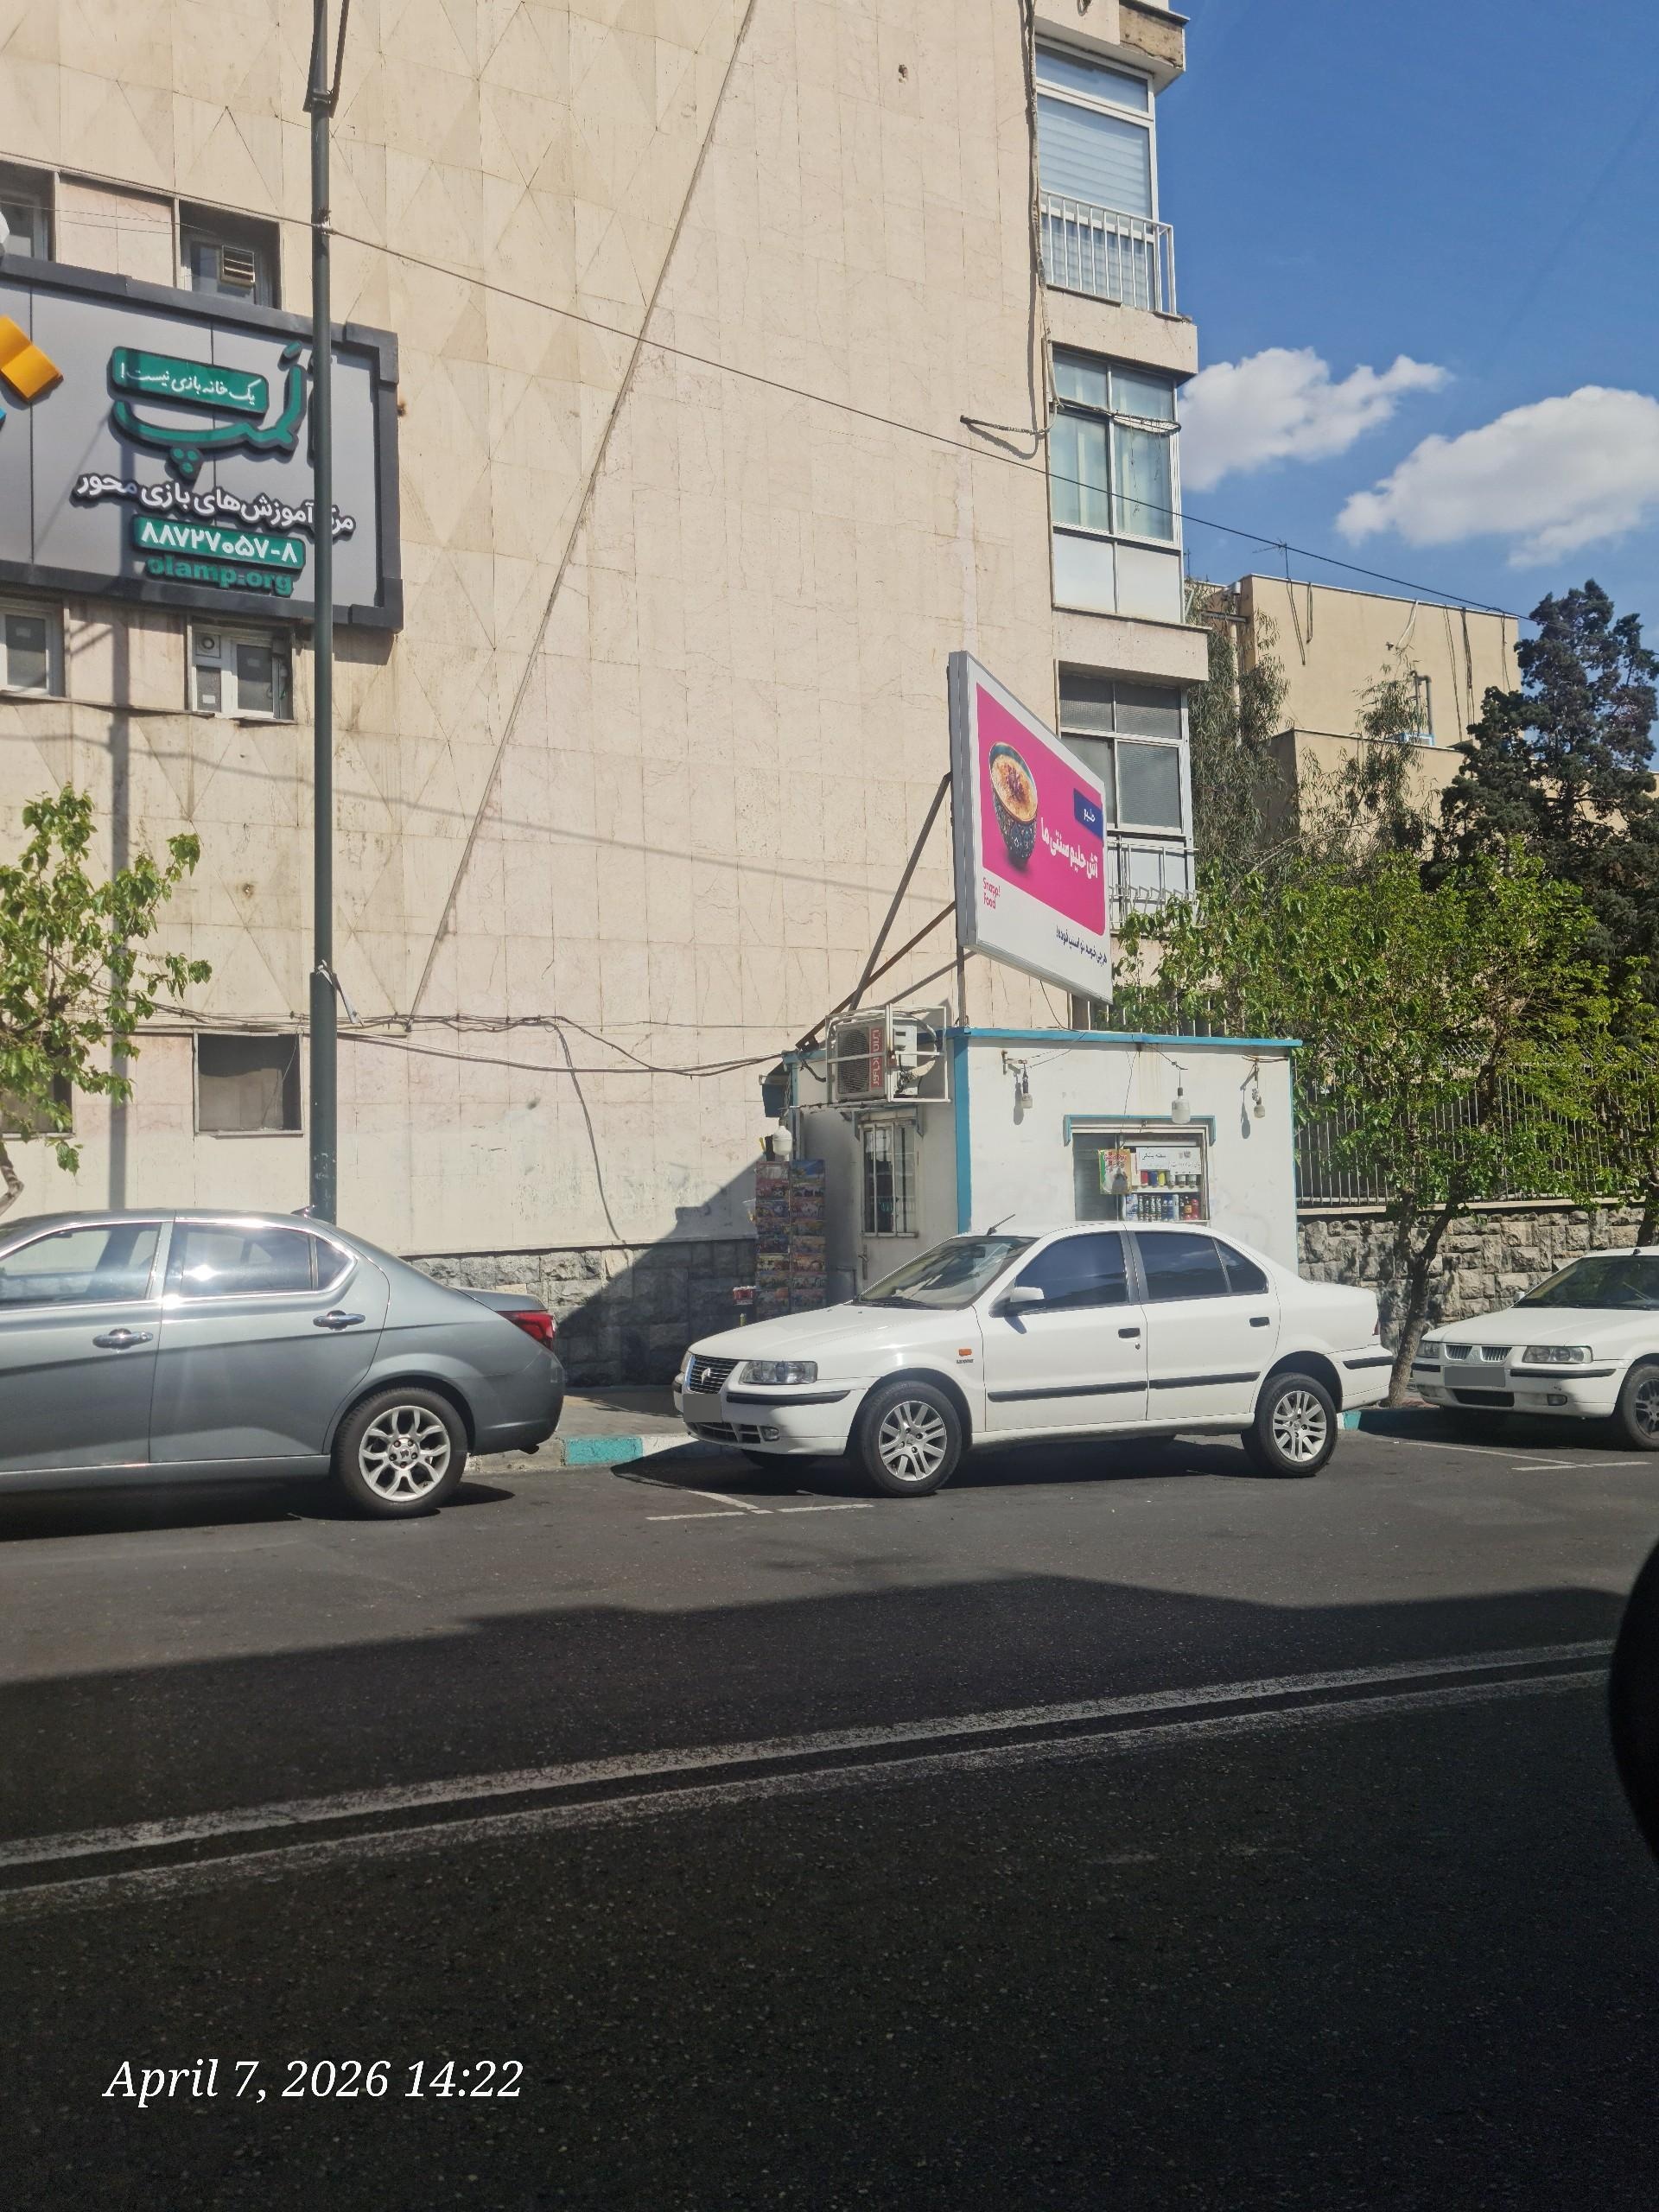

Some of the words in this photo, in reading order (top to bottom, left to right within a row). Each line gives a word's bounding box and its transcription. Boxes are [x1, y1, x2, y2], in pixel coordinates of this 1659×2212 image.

[171, 375, 201, 395] بازی
[202, 380, 228, 395] خانه
[228, 378, 262, 405] یک
[77, 475, 138, 496] محور
[141, 482, 191, 510] بازی
[147, 555, 294, 596] olamp.org
[1050, 830, 1070, 856] سنتی
[1070, 844, 1086, 874] حلیم
[1086, 852, 1098, 880] آش
[982, 877, 1001, 899] Snapp!
[983, 893, 996, 910] Food
